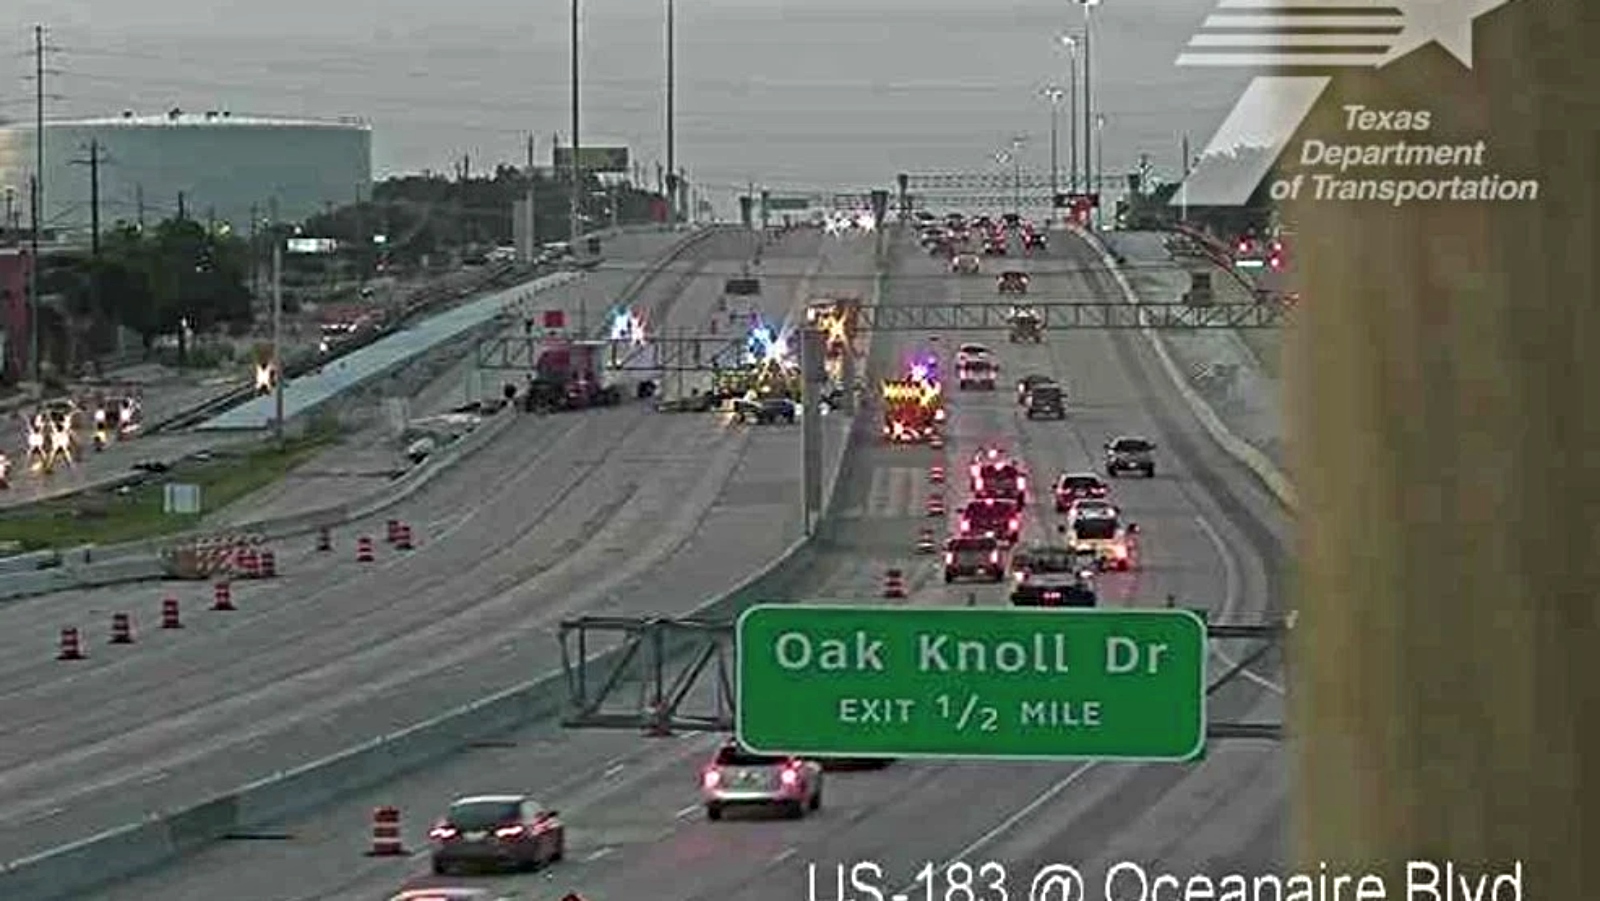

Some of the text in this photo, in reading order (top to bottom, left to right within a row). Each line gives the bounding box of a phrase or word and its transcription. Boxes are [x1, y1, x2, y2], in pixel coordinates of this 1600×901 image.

[775, 631, 1169, 674] Oak Knoll Dr
[839, 697, 915, 723] EXIT
[1020, 700, 1101, 726] MILE
